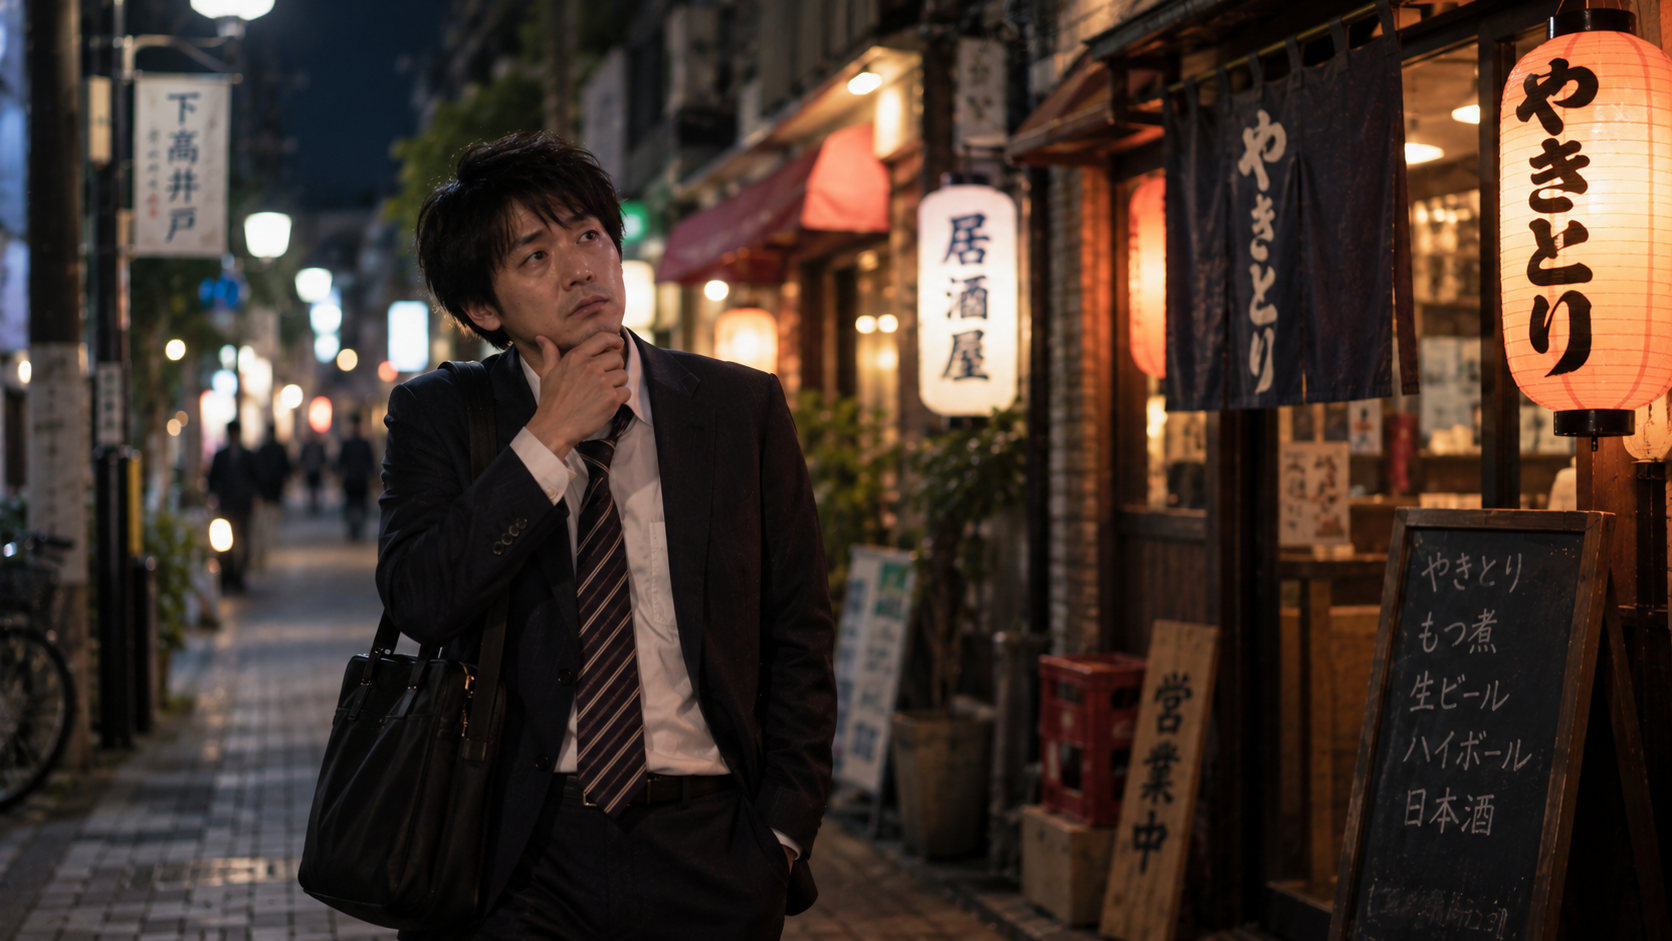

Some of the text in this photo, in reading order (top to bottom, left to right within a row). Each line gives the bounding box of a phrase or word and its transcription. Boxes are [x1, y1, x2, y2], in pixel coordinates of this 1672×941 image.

[166, 92, 200, 243] 下高井戸
[1515, 58, 1599, 377] やきとり
[943, 212, 991, 381] 居酒屋
[1238, 109, 1287, 395] やきとり
[1421, 552, 1522, 593] やきとり
[1418, 608, 1497, 654] もつ煮
[1410, 670, 1510, 712] 生ビール
[1132, 671, 1193, 875] 営業中
[1403, 730, 1532, 772] ハイボール
[1403, 787, 1495, 836] 日本酒
